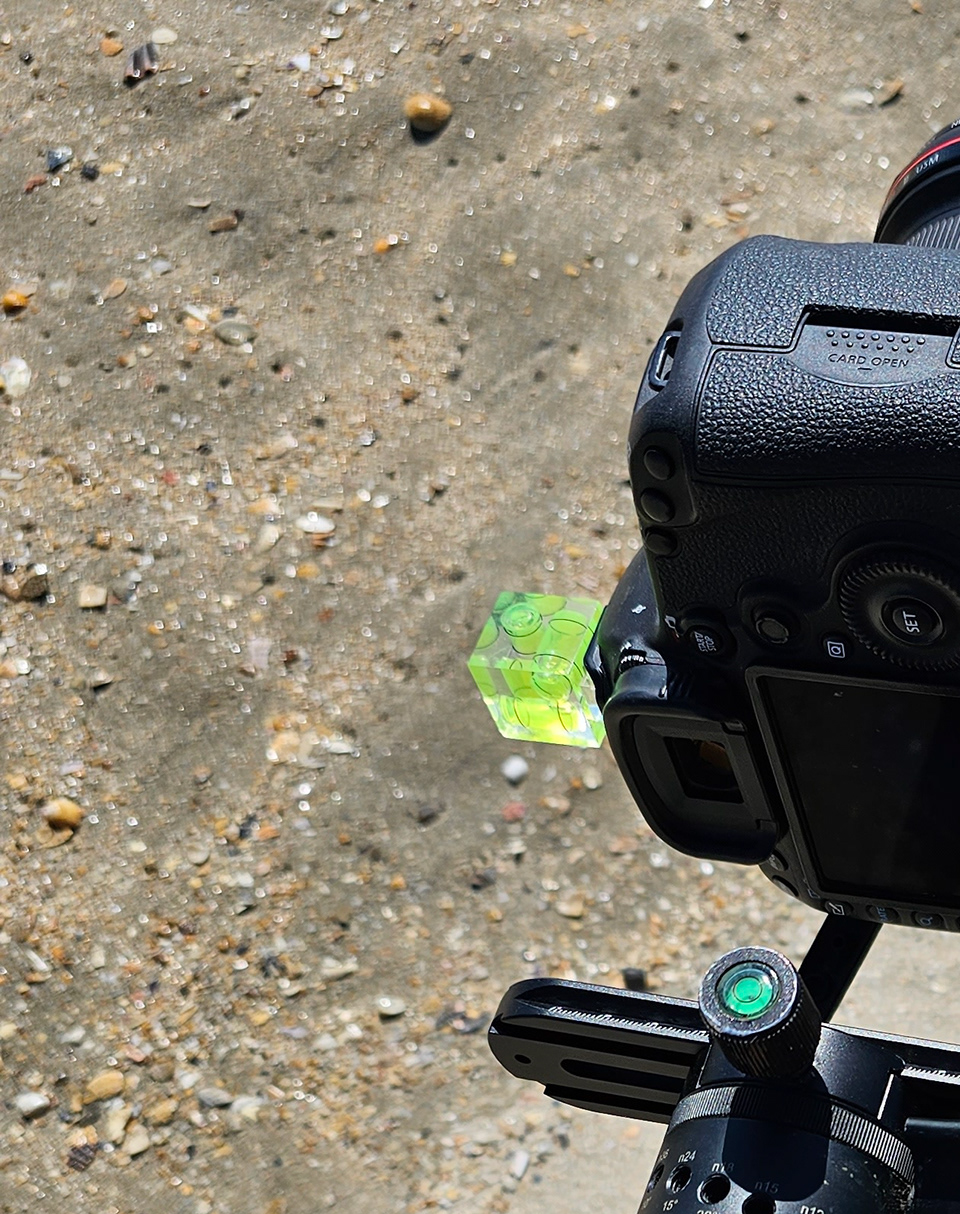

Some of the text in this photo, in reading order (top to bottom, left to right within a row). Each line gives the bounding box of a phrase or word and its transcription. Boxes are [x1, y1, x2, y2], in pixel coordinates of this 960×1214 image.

[828, 353, 909, 368] CARD OPEN
[904, 609, 919, 633] SET
[704, 635, 717, 652] STOP
[677, 1150, 697, 1163] n24
[711, 1161, 734, 1173] n18
[754, 1180, 779, 1195] n15
